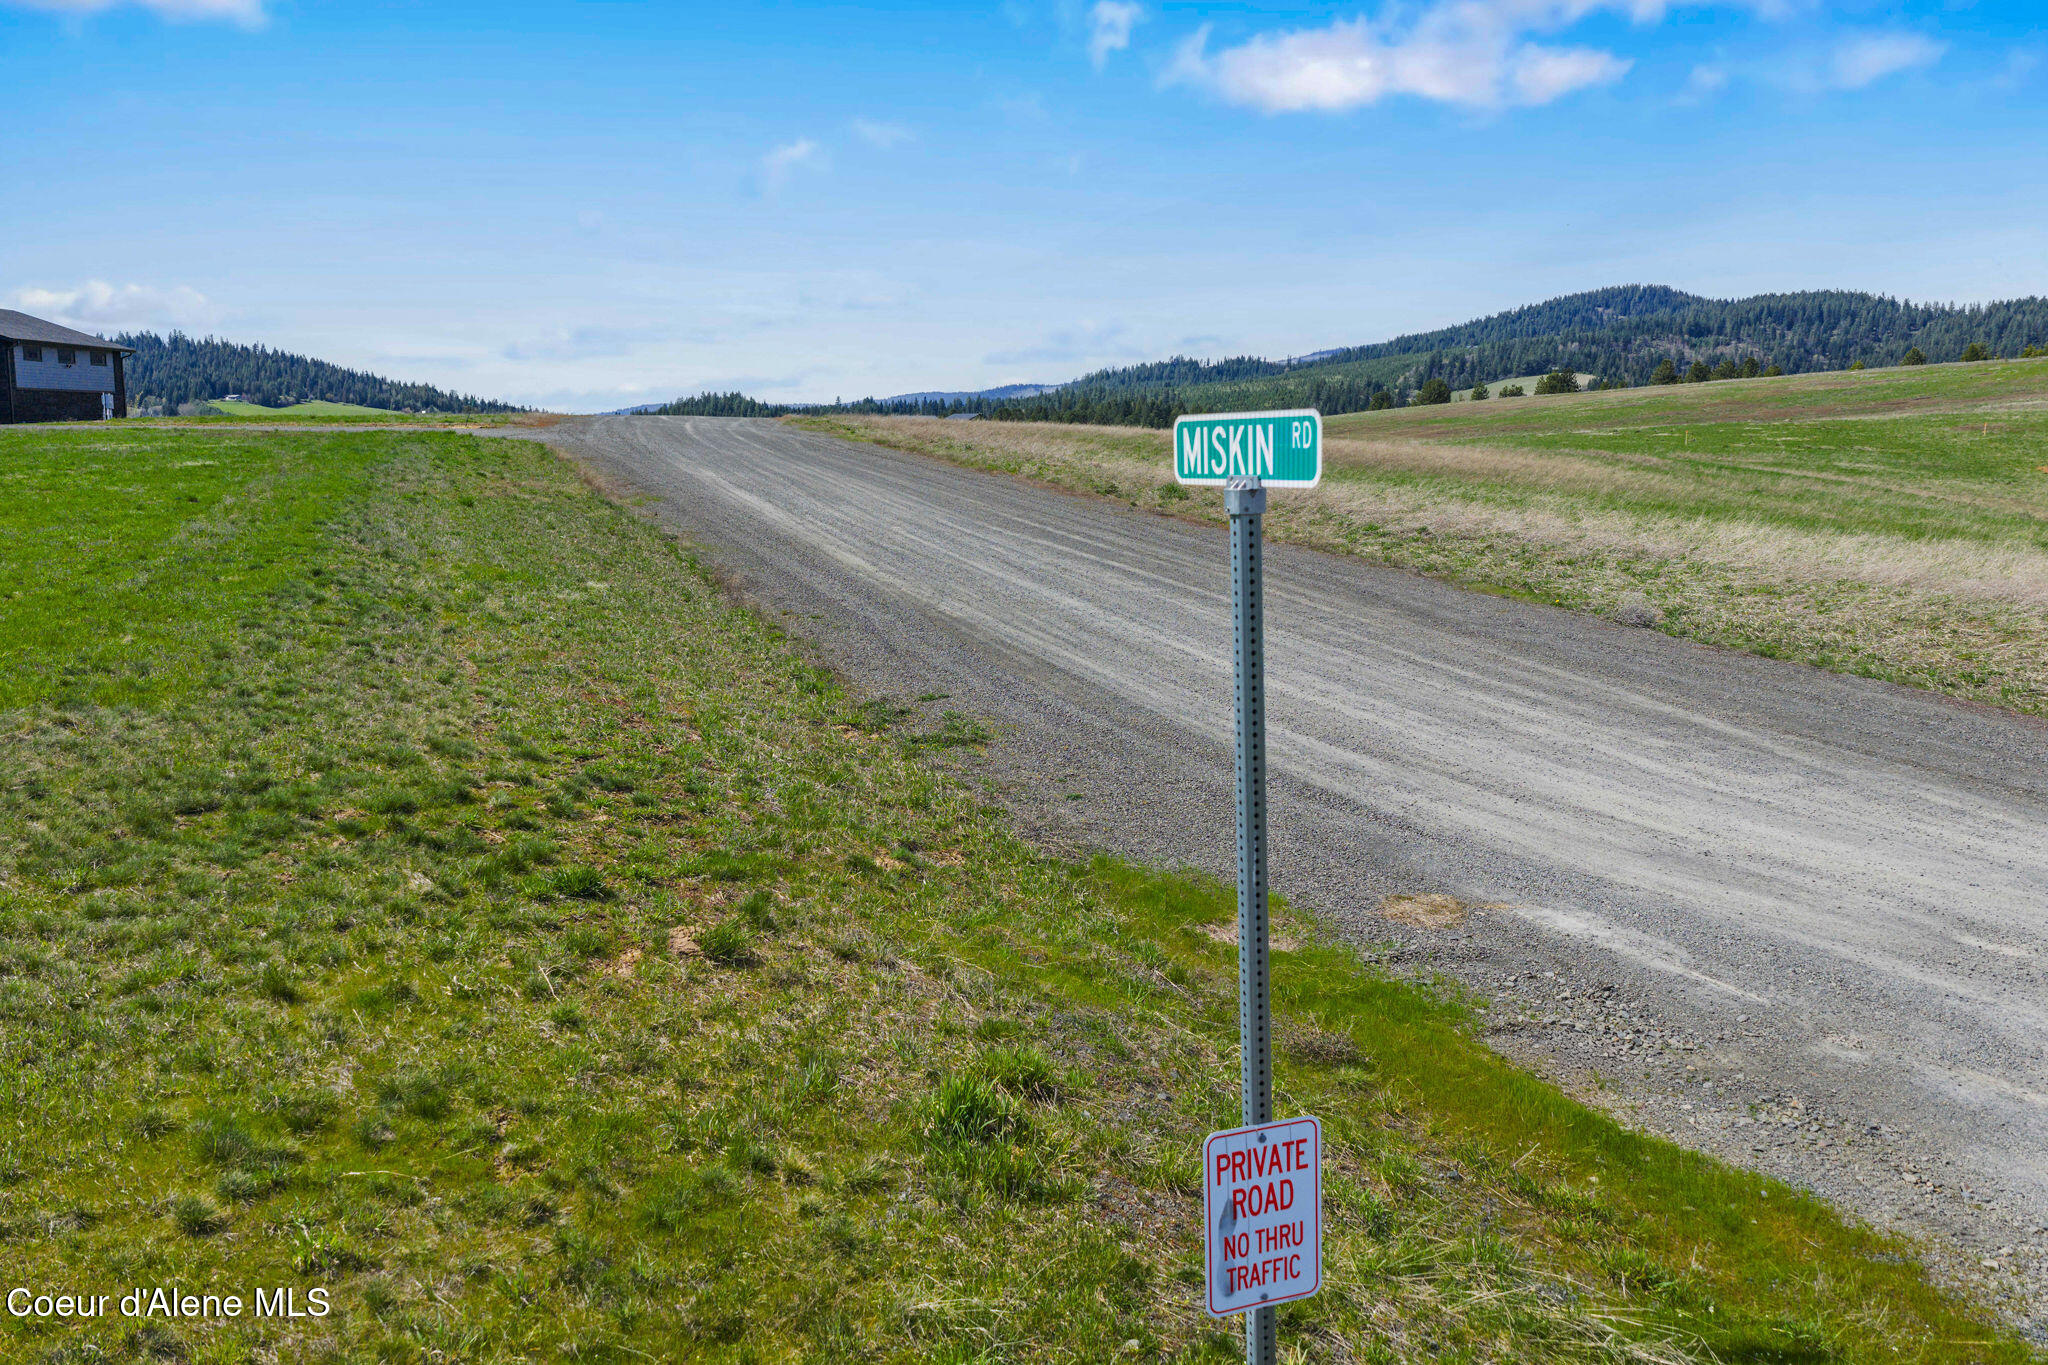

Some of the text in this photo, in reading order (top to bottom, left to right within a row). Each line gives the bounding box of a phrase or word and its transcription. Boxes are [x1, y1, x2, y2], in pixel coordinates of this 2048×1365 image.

[1183, 421, 1312, 475] MISKIN RD
[1216, 1138, 1309, 1186] PRIVATE
[1232, 1179, 1294, 1220] ROAD
[1224, 1221, 1304, 1261] NO THRU
[1226, 1254, 1301, 1294] TRAFFIC
